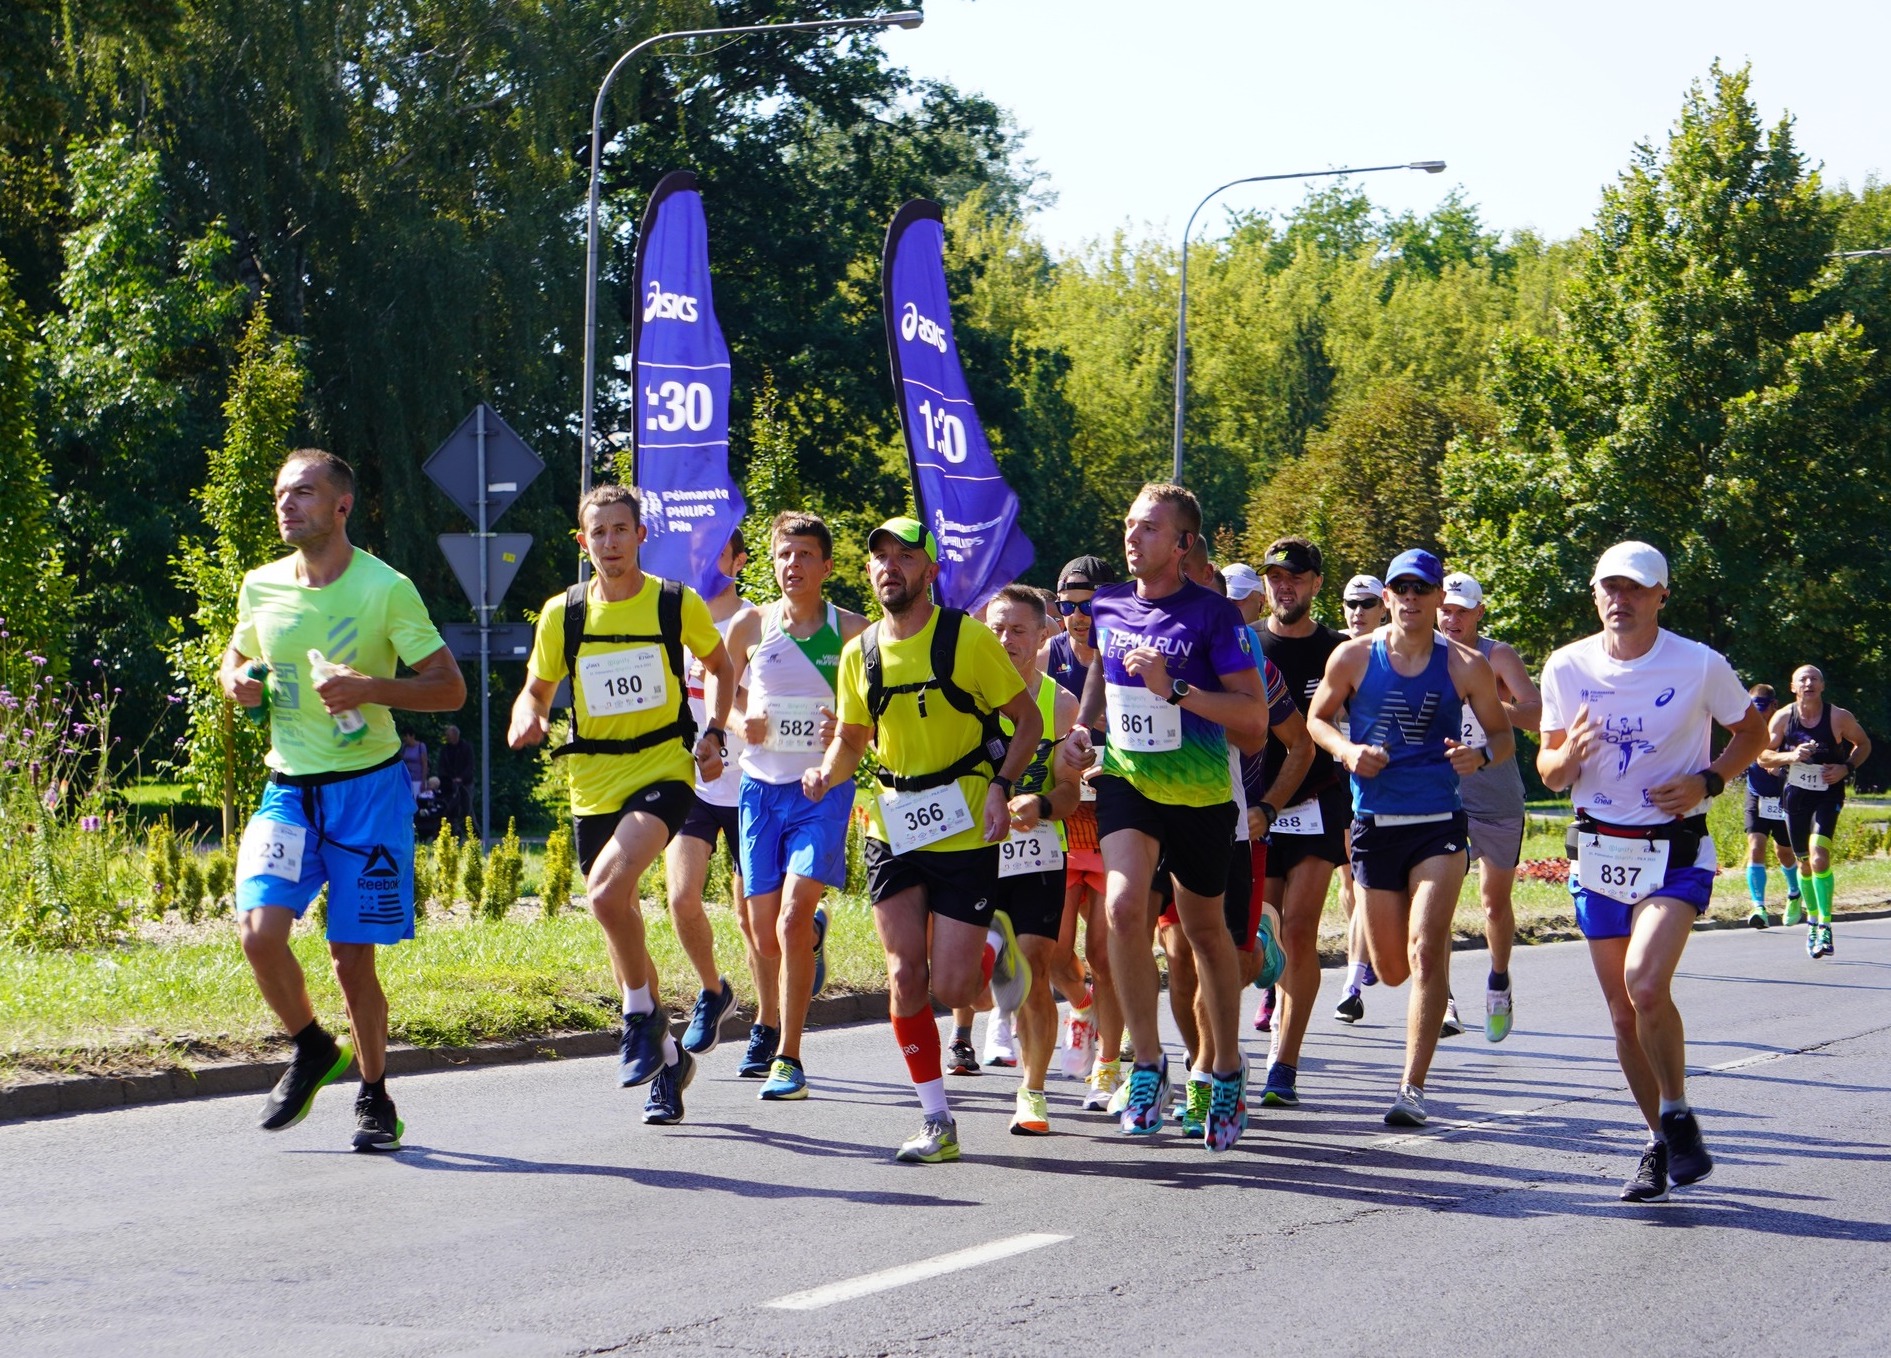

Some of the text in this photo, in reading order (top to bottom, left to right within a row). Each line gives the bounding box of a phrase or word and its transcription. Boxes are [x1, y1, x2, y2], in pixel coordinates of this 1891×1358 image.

[646, 381, 713, 432] :30
[665, 503, 716, 518] PHILIPS
[1110, 629, 1193, 657] TEAM RUN
[604, 675, 642, 697] 180
[780, 720, 815, 736] 582
[1121, 713, 1153, 734] 861
[1800, 773, 1817, 783] 411
[905, 803, 944, 831] 366
[1002, 838, 1041, 860] 973
[358, 877, 399, 890] Reebok
[1601, 864, 1642, 887] 837
[903, 1044, 920, 1057] RB
